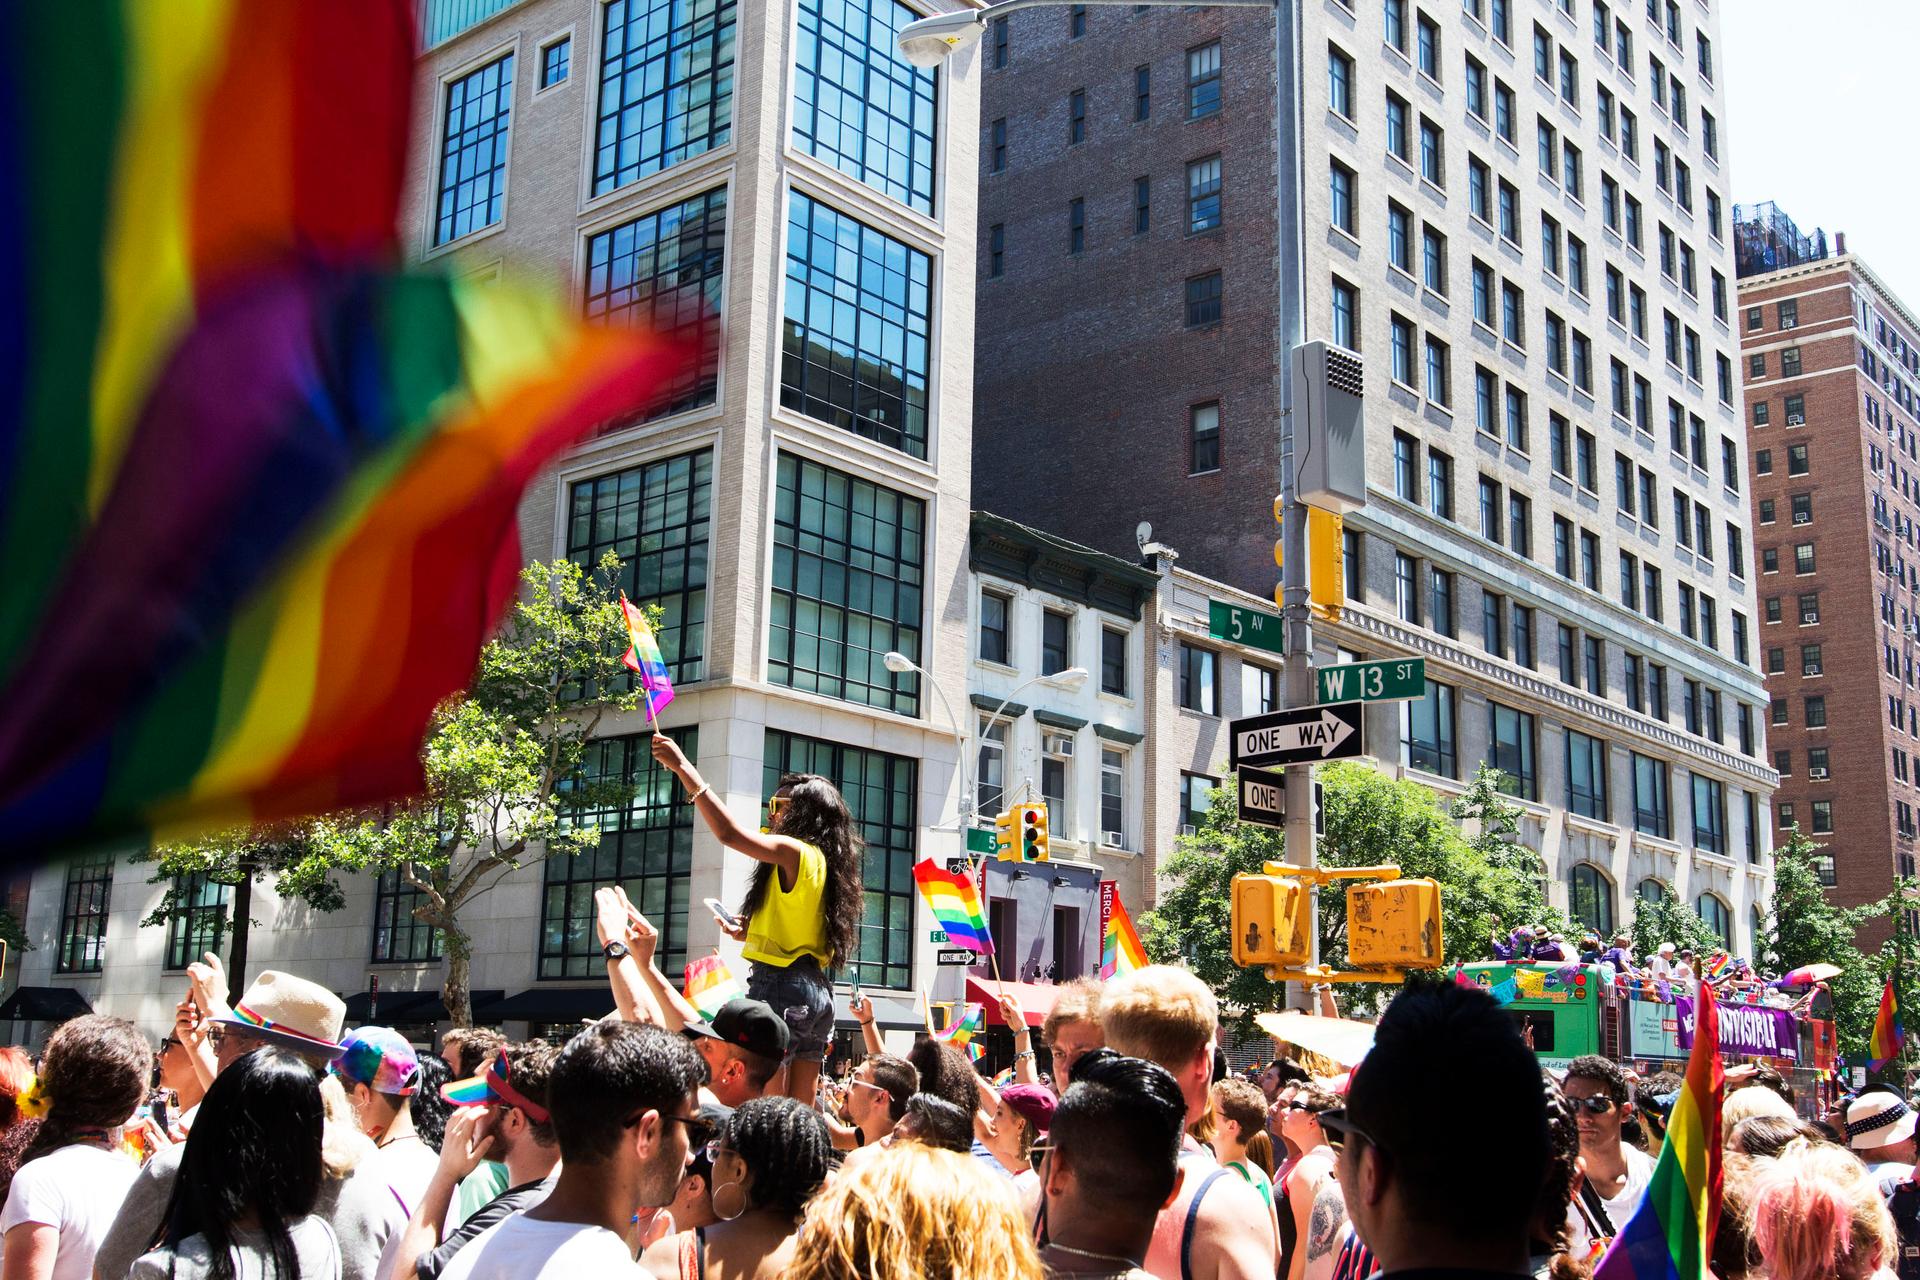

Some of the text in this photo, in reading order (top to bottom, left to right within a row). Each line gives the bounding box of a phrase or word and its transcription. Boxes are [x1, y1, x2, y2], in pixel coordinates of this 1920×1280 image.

[1231, 608, 1264, 640] 5 AV
[1324, 663, 1413, 701] W 13 ST
[1246, 721, 1340, 753] ONE WAY
[1251, 785, 1277, 809] ONE
[988, 835, 996, 850] 5
[1103, 884, 1112, 918] MERCI
[933, 931, 947, 942] E 13
[942, 953, 972, 962] ONE WAY
